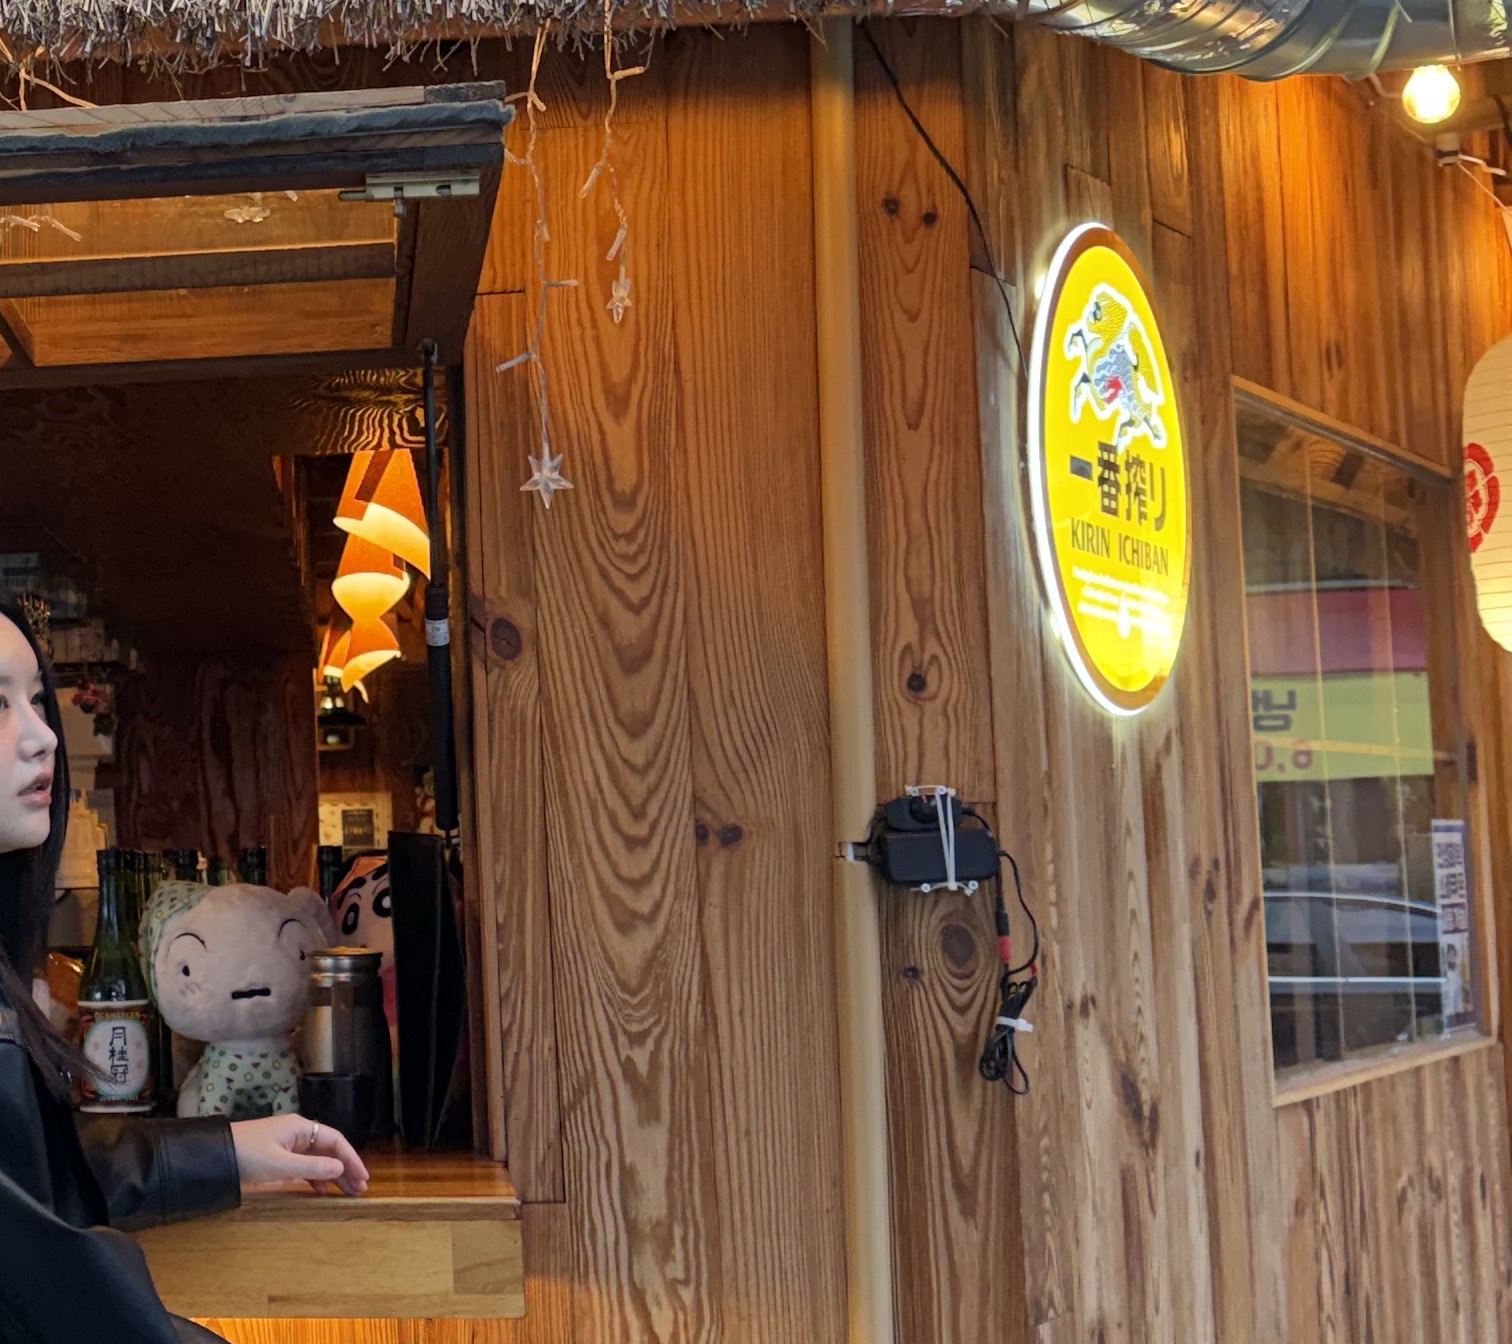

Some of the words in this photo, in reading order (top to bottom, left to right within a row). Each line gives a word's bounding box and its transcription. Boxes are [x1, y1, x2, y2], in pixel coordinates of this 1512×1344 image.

[1069, 441, 1167, 532] 一番搾り
[1071, 517, 1110, 559] KIRIN
[1117, 532, 1168, 577] ICHIBAN
[108, 1026, 129, 1085] 月桂冠
